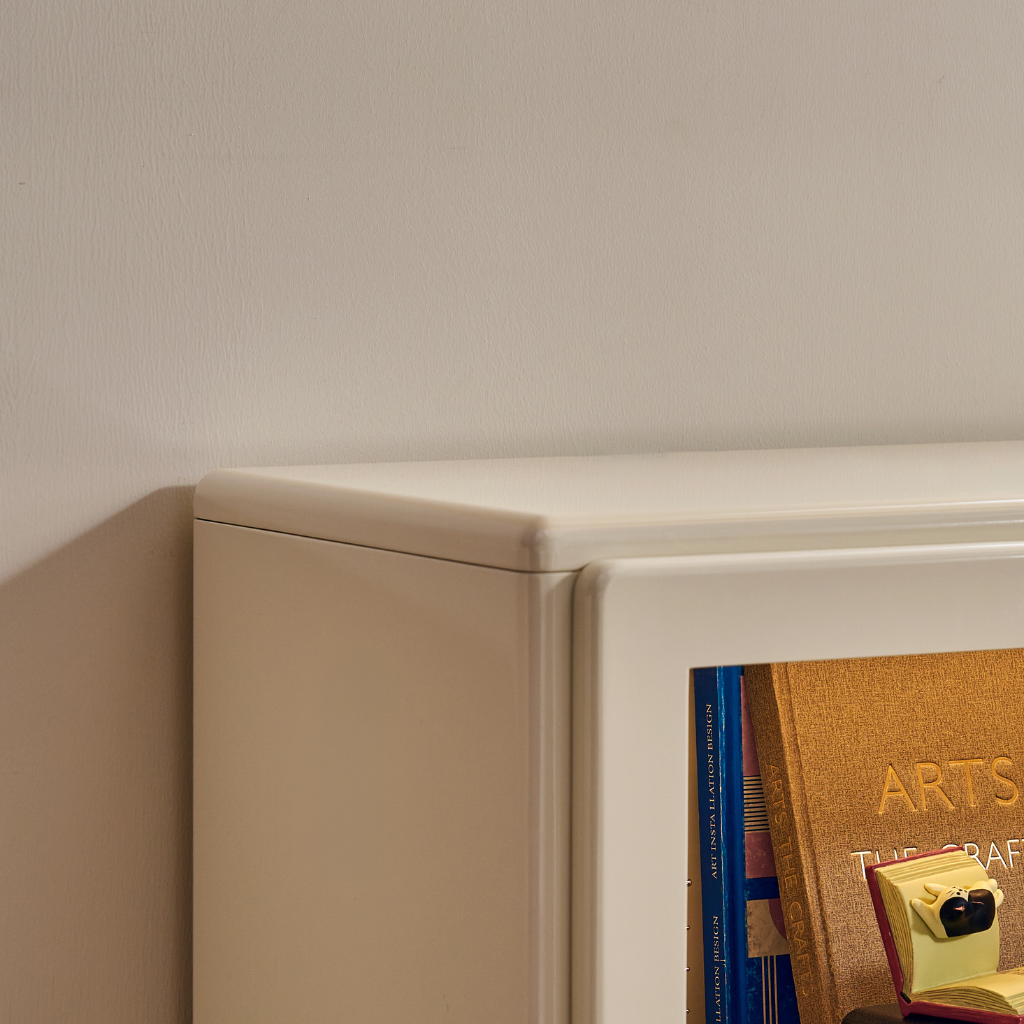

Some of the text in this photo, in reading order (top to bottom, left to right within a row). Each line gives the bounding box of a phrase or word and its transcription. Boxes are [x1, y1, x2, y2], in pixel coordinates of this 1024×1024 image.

[878, 756, 1018, 815] ARTS
[767, 764, 788, 824] ARTS
[780, 836, 798, 890] THE
[710, 854, 718, 880] ART
